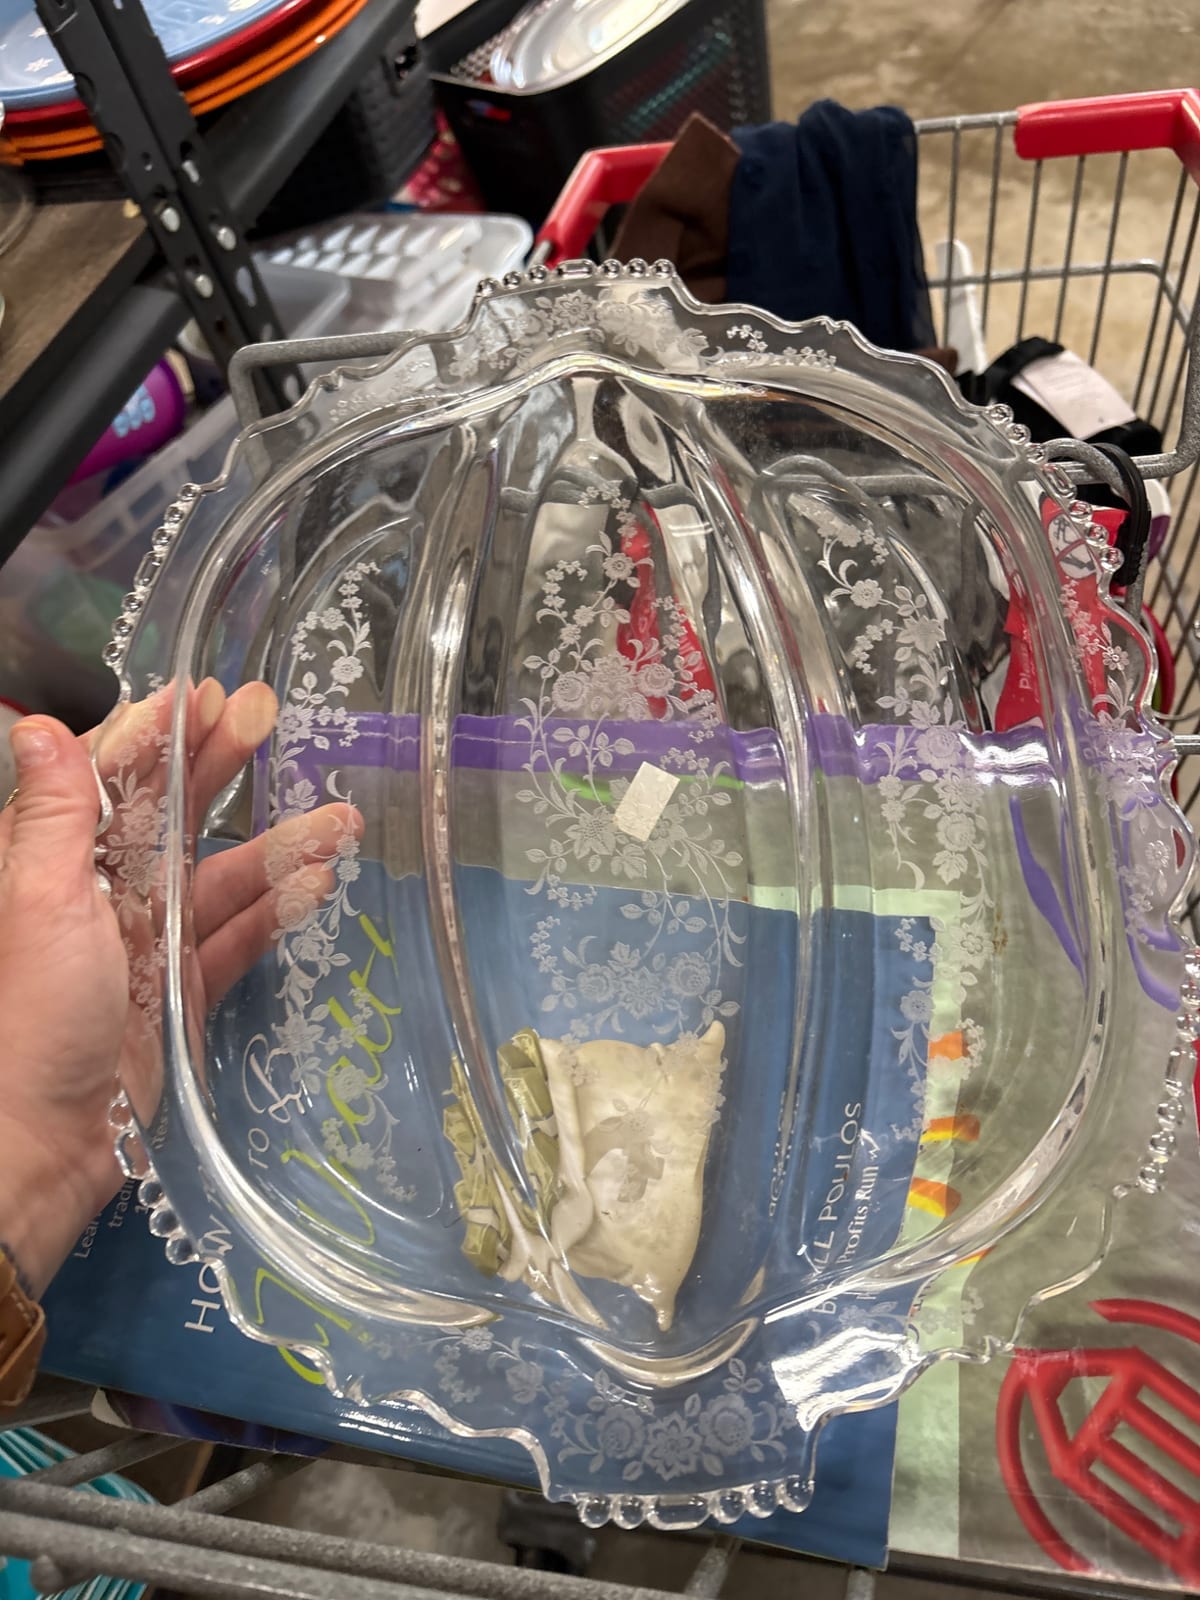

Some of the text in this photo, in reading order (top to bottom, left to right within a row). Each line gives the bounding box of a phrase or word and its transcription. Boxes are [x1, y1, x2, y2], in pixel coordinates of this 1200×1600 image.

[818, 1102, 862, 1221] POULOS
[836, 1206, 869, 1264] Profits
[855, 1166, 880, 1202] Run
[75, 1207, 101, 1258] Lear
[184, 1127, 271, 1333] HOW TO
